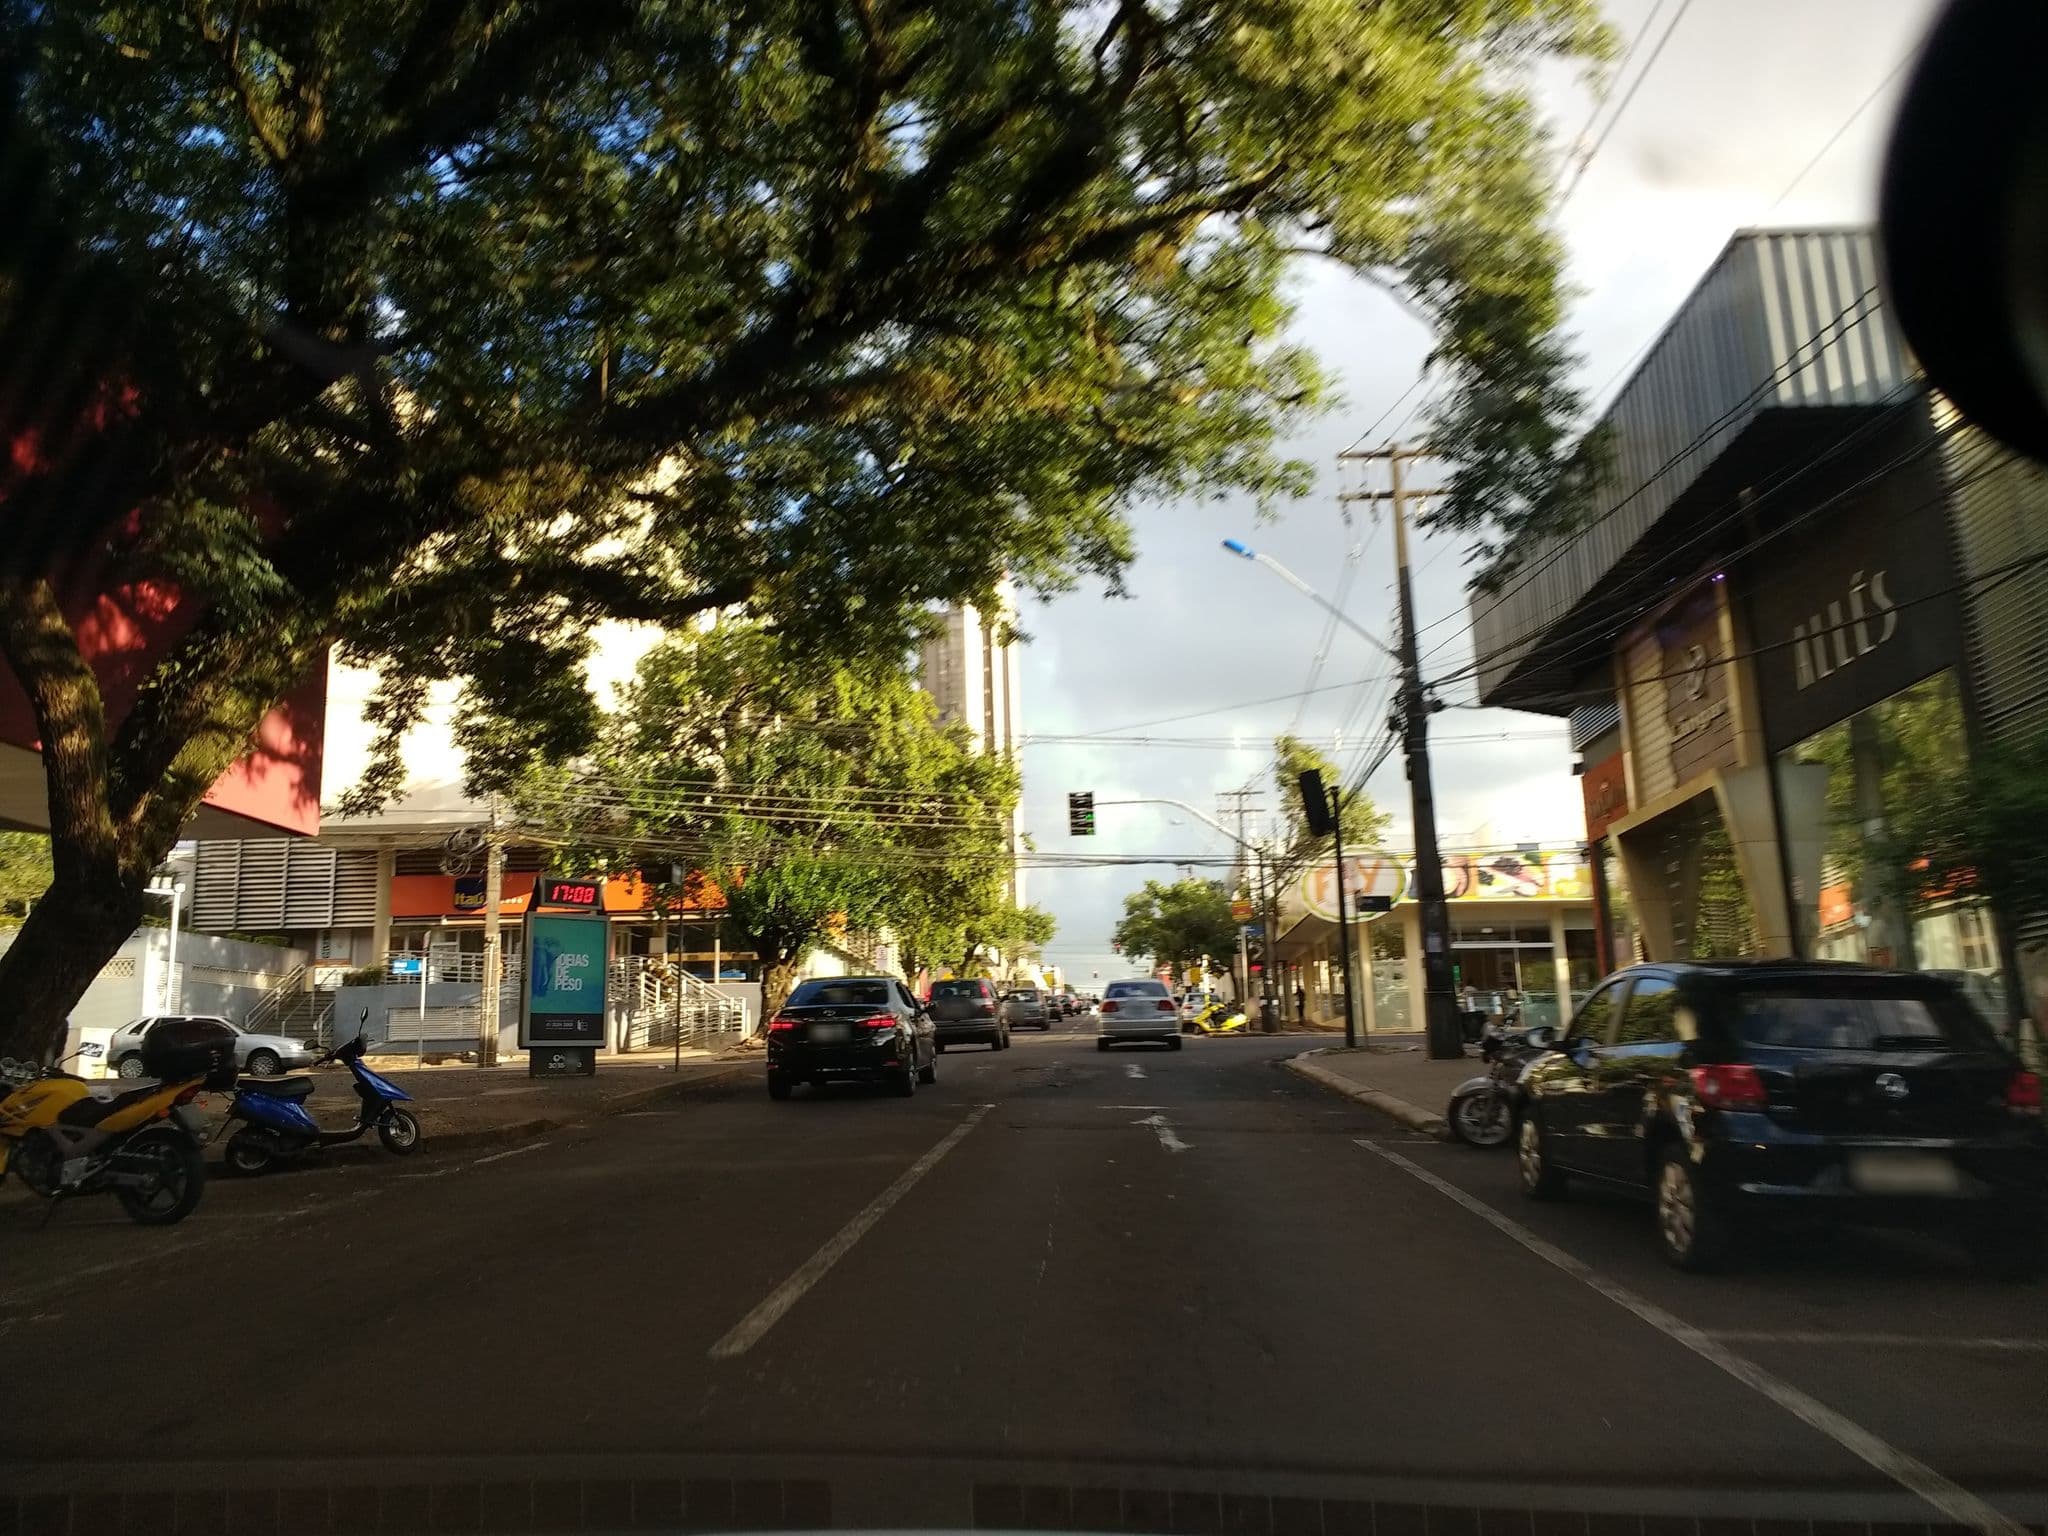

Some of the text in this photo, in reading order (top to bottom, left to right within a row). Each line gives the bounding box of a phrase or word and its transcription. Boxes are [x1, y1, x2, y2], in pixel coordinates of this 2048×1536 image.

[552, 885, 595, 903] 17:08
[555, 966, 569, 978] DE
[554, 977, 582, 991] PESO
